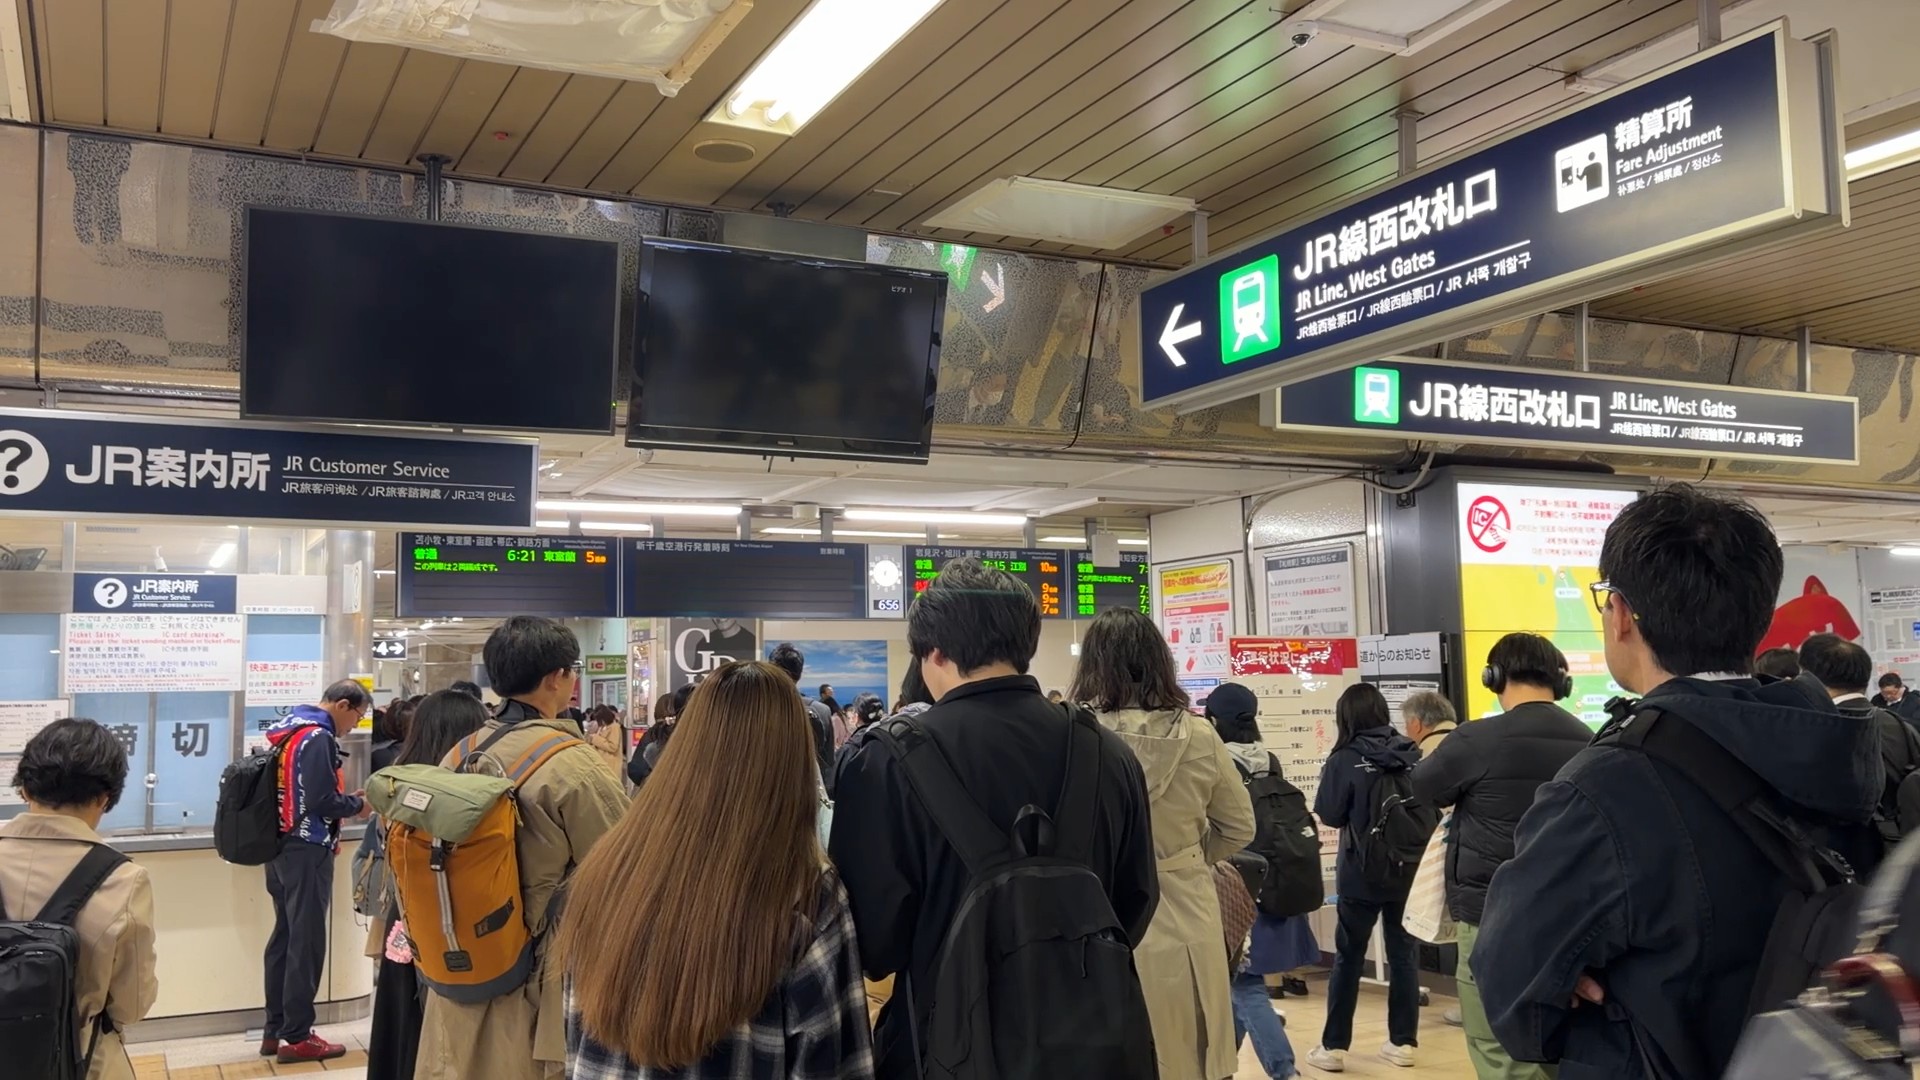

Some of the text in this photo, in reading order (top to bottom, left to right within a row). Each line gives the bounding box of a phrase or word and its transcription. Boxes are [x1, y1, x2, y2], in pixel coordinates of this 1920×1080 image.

[1614, 95, 1693, 152] 精算所
[1616, 125, 1722, 175] Fare Adjustment
[1692, 152, 1722, 171] 정산소
[1293, 168, 1497, 280] JR線西改札口
[1295, 250, 1436, 313] JR Line, West Gates
[1445, 276, 1462, 293] JR
[1465, 265, 1489, 286] 서쪽
[1493, 252, 1531, 277] 개찰구
[891, 285, 906, 293] ビデオ
[1409, 381, 1600, 429] JR線西改札口
[1610, 391, 1737, 419] JR Line, West Gates
[1742, 432, 1757, 444] JR
[65, 444, 271, 492] JR案内所
[282, 455, 450, 479] JR Customer Service
[451, 489, 485, 501] JR고객
[487, 491, 516, 502] 안내소
[507, 549, 536, 562] 6:21
[983, 561, 1006, 571] 7:15
[132, 579, 199, 594] JR案内所
[250, 662, 317, 672] 快速エアポート
[172, 722, 209, 757] 切
